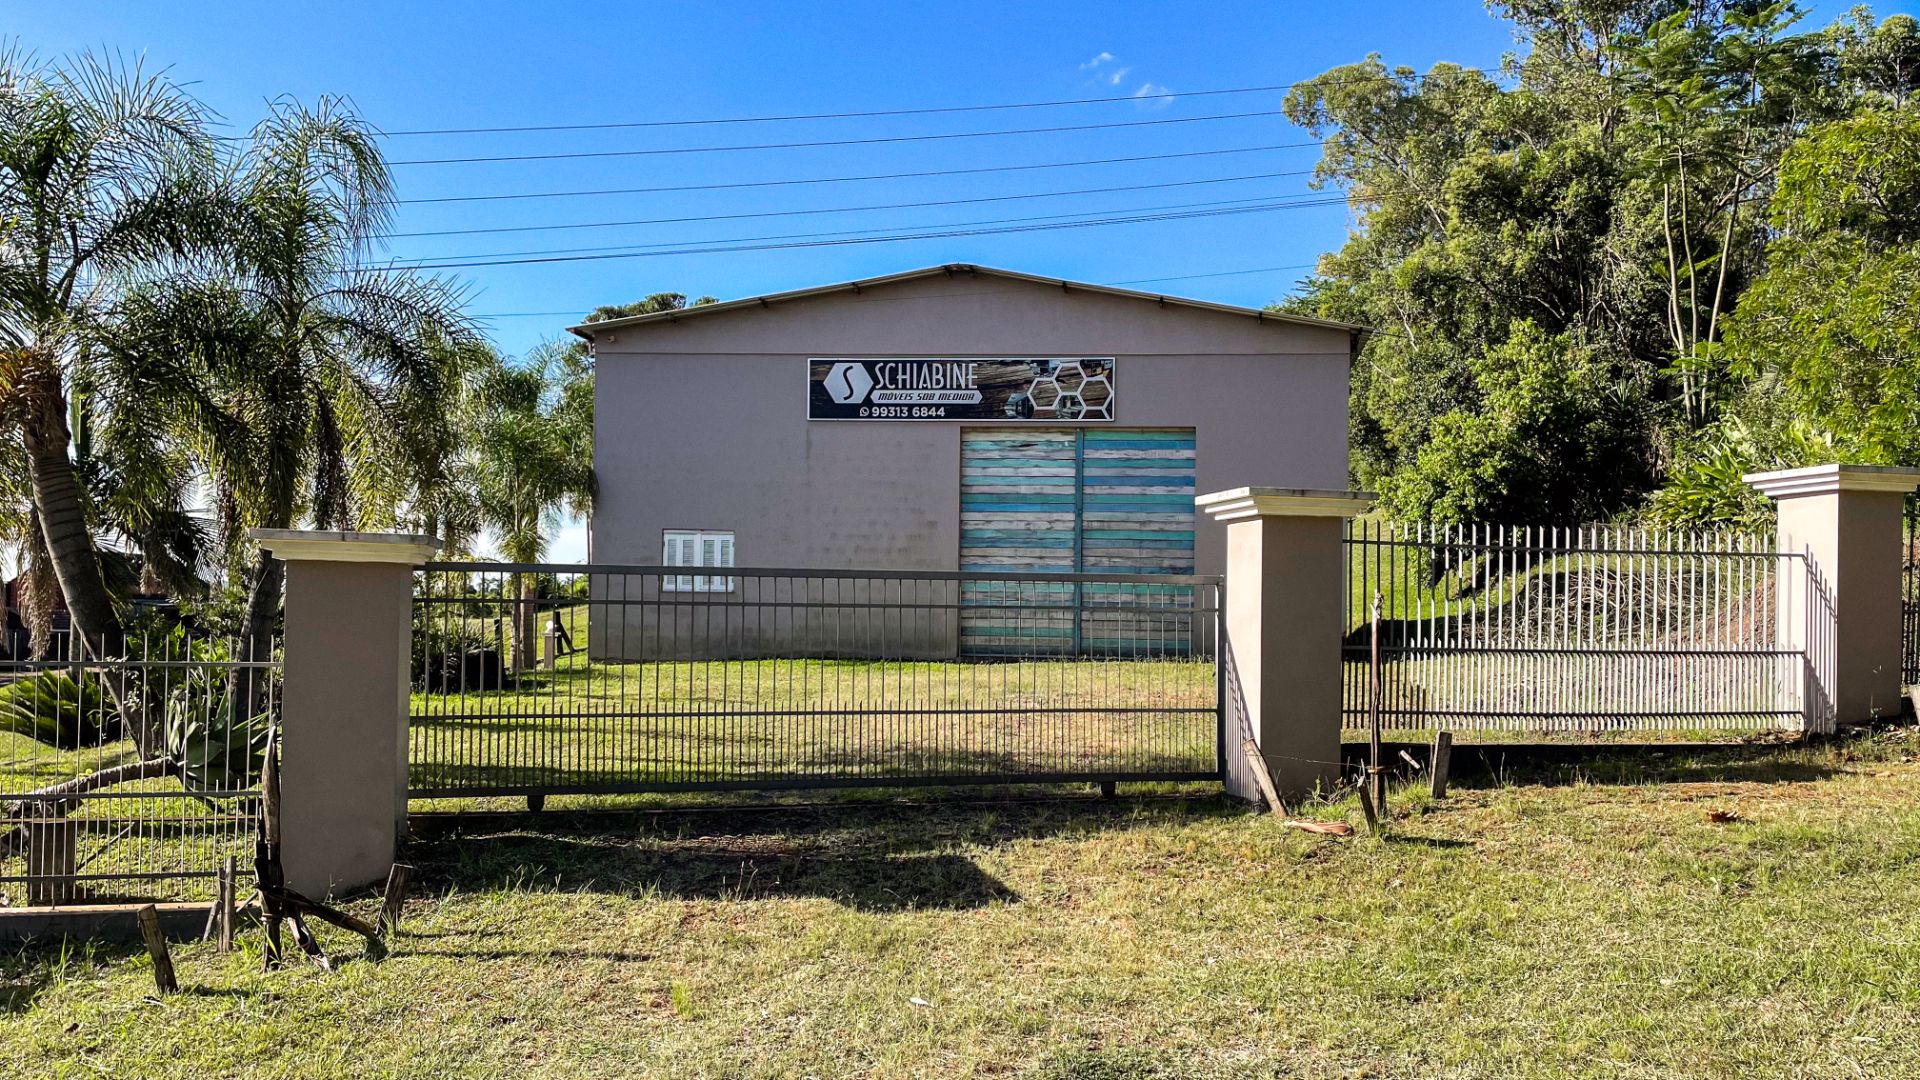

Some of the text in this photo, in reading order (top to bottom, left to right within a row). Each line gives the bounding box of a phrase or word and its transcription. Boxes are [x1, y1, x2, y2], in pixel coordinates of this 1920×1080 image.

[843, 365, 854, 401] S
[874, 362, 978, 389] SCHIABINE
[916, 391, 936, 401] SOB
[937, 391, 976, 401] MEDIDA
[871, 406, 946, 417] 99313 6844
